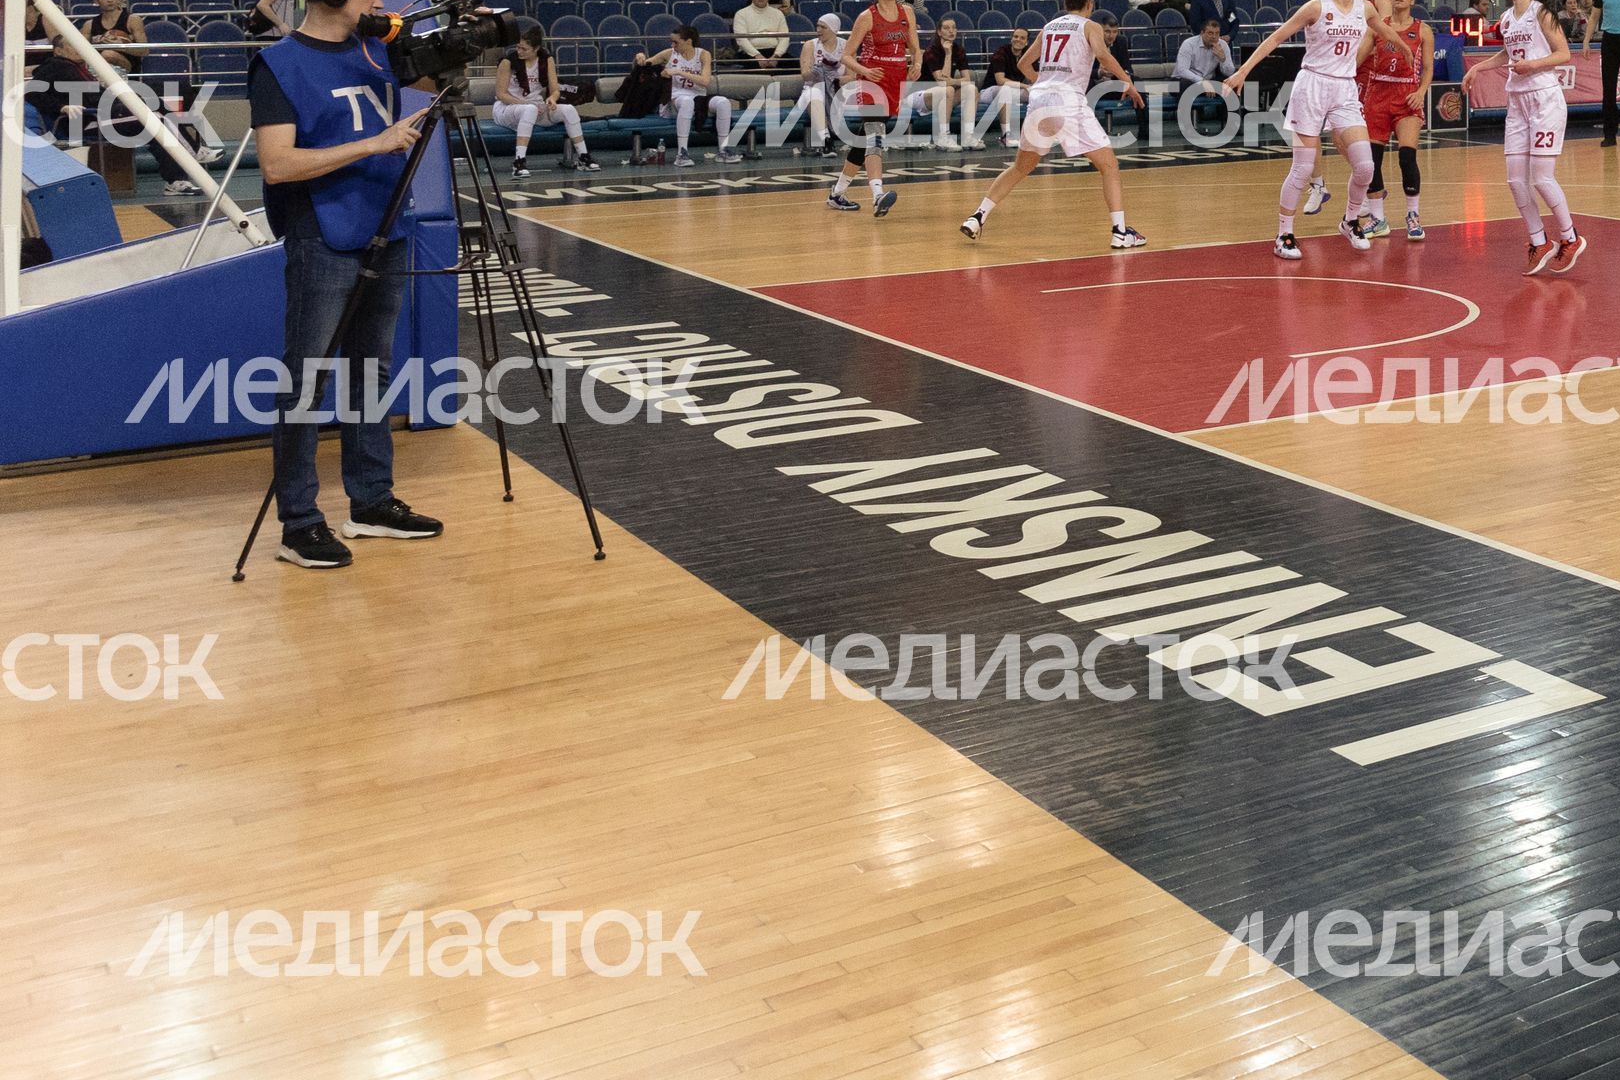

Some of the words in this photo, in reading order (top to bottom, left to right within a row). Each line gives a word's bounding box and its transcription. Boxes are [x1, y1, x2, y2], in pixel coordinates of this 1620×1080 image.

[1327, 27, 1361, 36] СПАРТАК
[1044, 34, 1071, 63] 17
[1334, 41, 1350, 56] 81
[1389, 58, 1397, 72] 3
[331, 82, 394, 131] TV
[1534, 131, 1555, 148] 23
[510, 321, 924, 449] DISTRICT
[775, 447, 1608, 767] LENINSKIY
